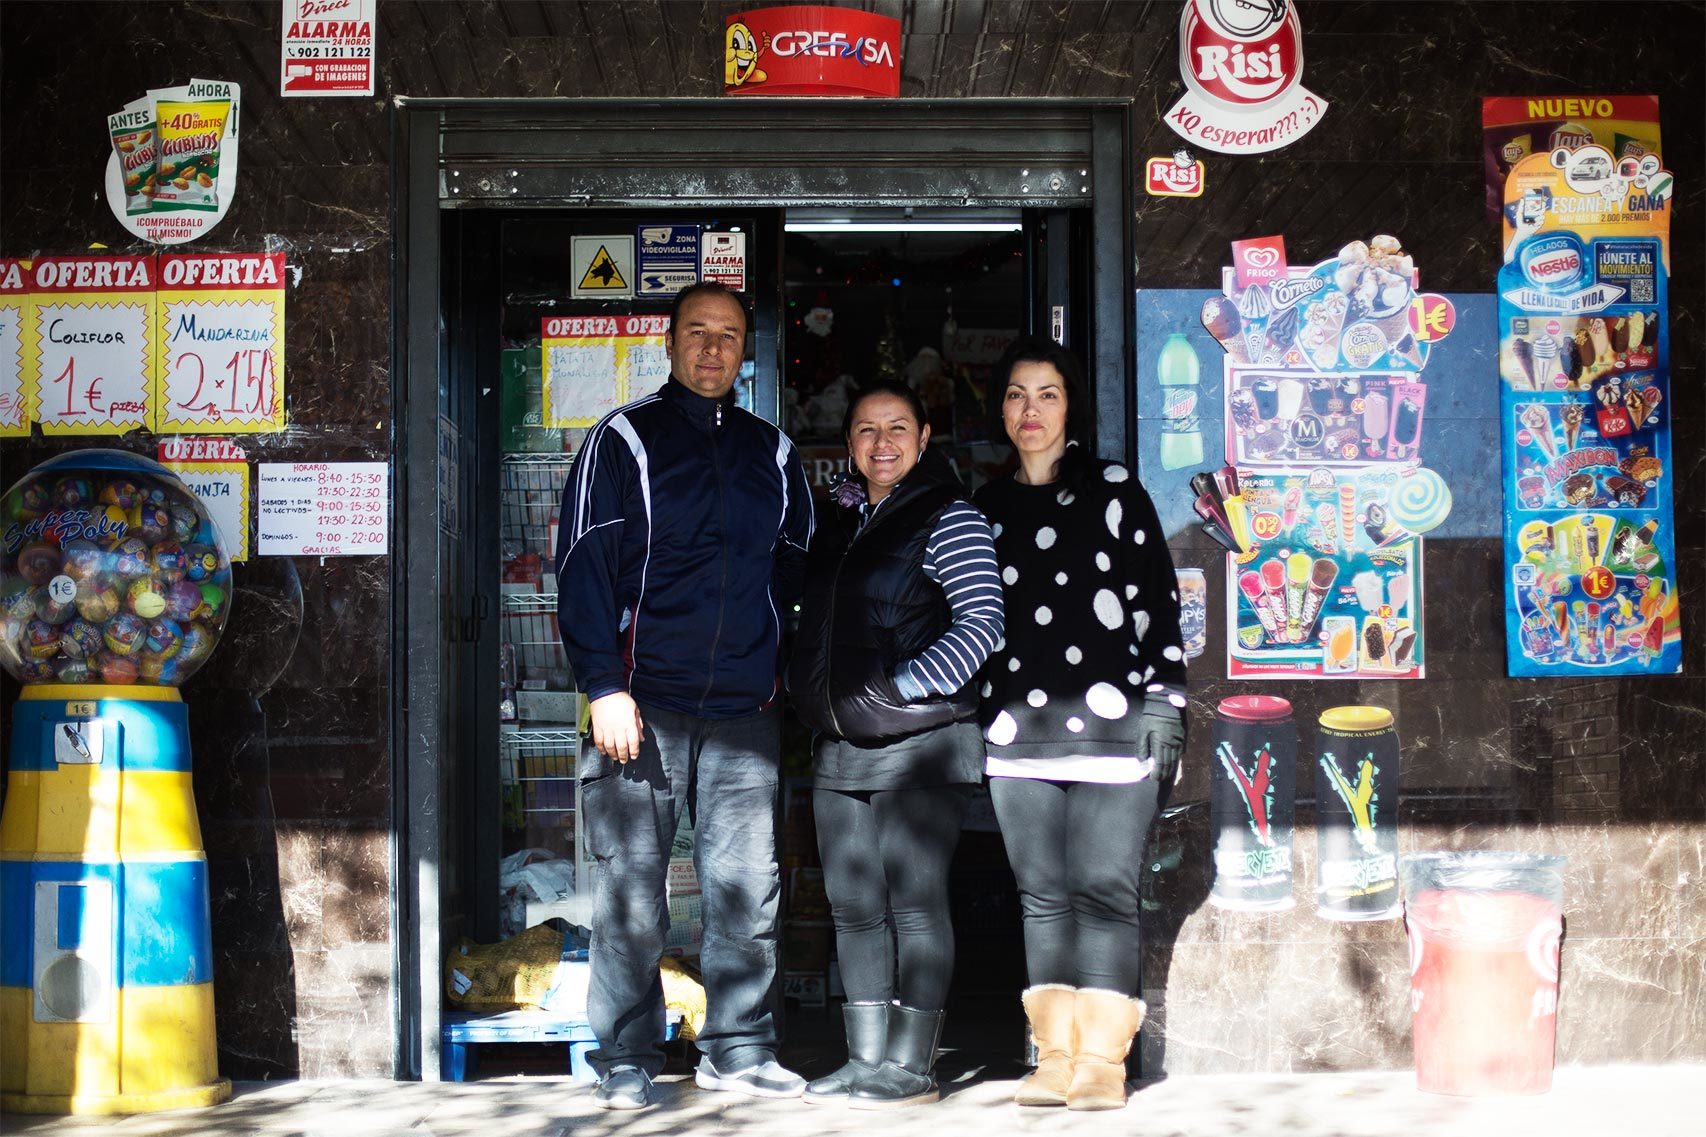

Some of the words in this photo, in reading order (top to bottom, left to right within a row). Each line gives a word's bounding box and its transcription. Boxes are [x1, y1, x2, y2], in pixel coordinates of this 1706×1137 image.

[287, 22, 371, 38] ALARMA
[298, 47, 319, 57] 902
[325, 47, 344, 57] 121
[350, 47, 371, 57] 122
[771, 31, 894, 68] GREFUSA
[315, 73, 325, 81] DE
[327, 73, 367, 81] IMAGENES
[1197, 43, 1287, 98] Risi
[188, 84, 231, 97] AHORA
[1528, 98, 1614, 118] NUEVO
[110, 110, 150, 129] ANTES
[192, 118, 222, 129] GRATIS
[1153, 163, 1199, 191] Risi
[1552, 196, 1614, 215] ESCANEA
[1628, 195, 1665, 212] GANA
[137, 216, 203, 227] ¡COMPRUÉBALO
[147, 228, 158, 239] TÚ
[159, 229, 192, 239] MISMO!
[641, 246, 697, 254] VIDEOVIGILADA
[1531, 241, 1568, 256] HELADOS
[704, 257, 744, 265] ALARMA
[1639, 253, 1653, 264] AL
[36, 261, 149, 289] OFERTA
[163, 257, 278, 286] OFERTA
[1247, 269, 1277, 278] FRIGO
[1600, 264, 1653, 274] MOVIMIENTO!
[1269, 277, 1324, 311] Cornetto
[1521, 290, 1545, 307] LLENA
[1571, 298, 1581, 310] DE
[1582, 289, 1605, 307] VIDA
[1412, 297, 1451, 340] 1€
[50, 318, 126, 345] COLIFLOR
[547, 319, 619, 336] OFERTA
[1544, 447, 1618, 484] MAXIBON
[318, 473, 343, 484] 8:40
[350, 473, 382, 484] 15:30
[317, 501, 344, 511] 9:00
[350, 501, 382, 511] 15:30
[4, 510, 90, 553] Super
[56, 519, 129, 550] Poly
[316, 531, 342, 543] 9:00
[351, 532, 384, 544] 22:00
[51, 582, 75, 596] 1€
[1588, 571, 1610, 595] 1€
[74, 704, 90, 714] 1€
